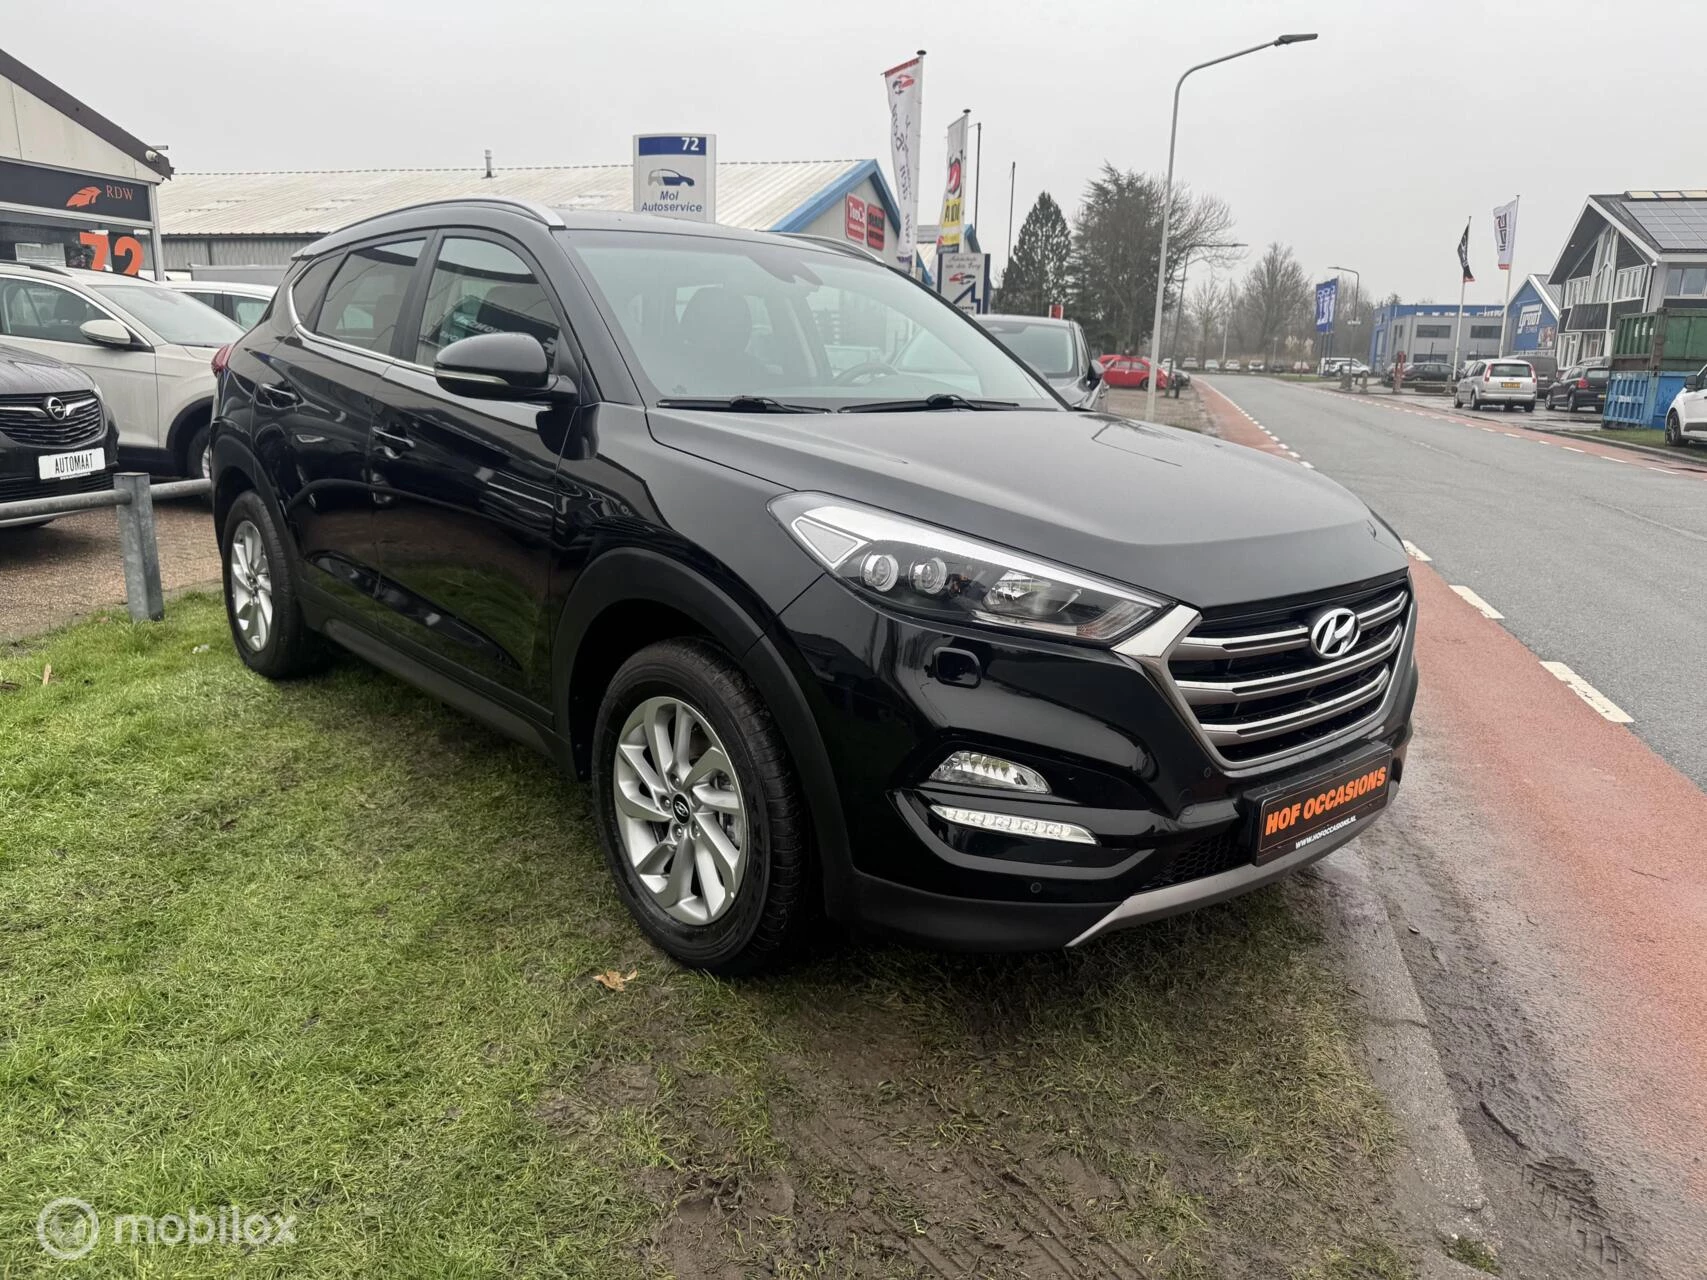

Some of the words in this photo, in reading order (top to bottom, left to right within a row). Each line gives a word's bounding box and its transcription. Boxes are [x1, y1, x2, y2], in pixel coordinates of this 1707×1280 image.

[681, 137, 700, 152] 72
[106, 184, 134, 201] RDW
[659, 190, 679, 201] Mol
[640, 201, 703, 212] Autoservice
[79, 231, 144, 277] 72
[54, 452, 94, 474] AUTOMAAT
[1264, 802, 1301, 836] HOF
[1303, 766, 1387, 821] OCCASIONS
